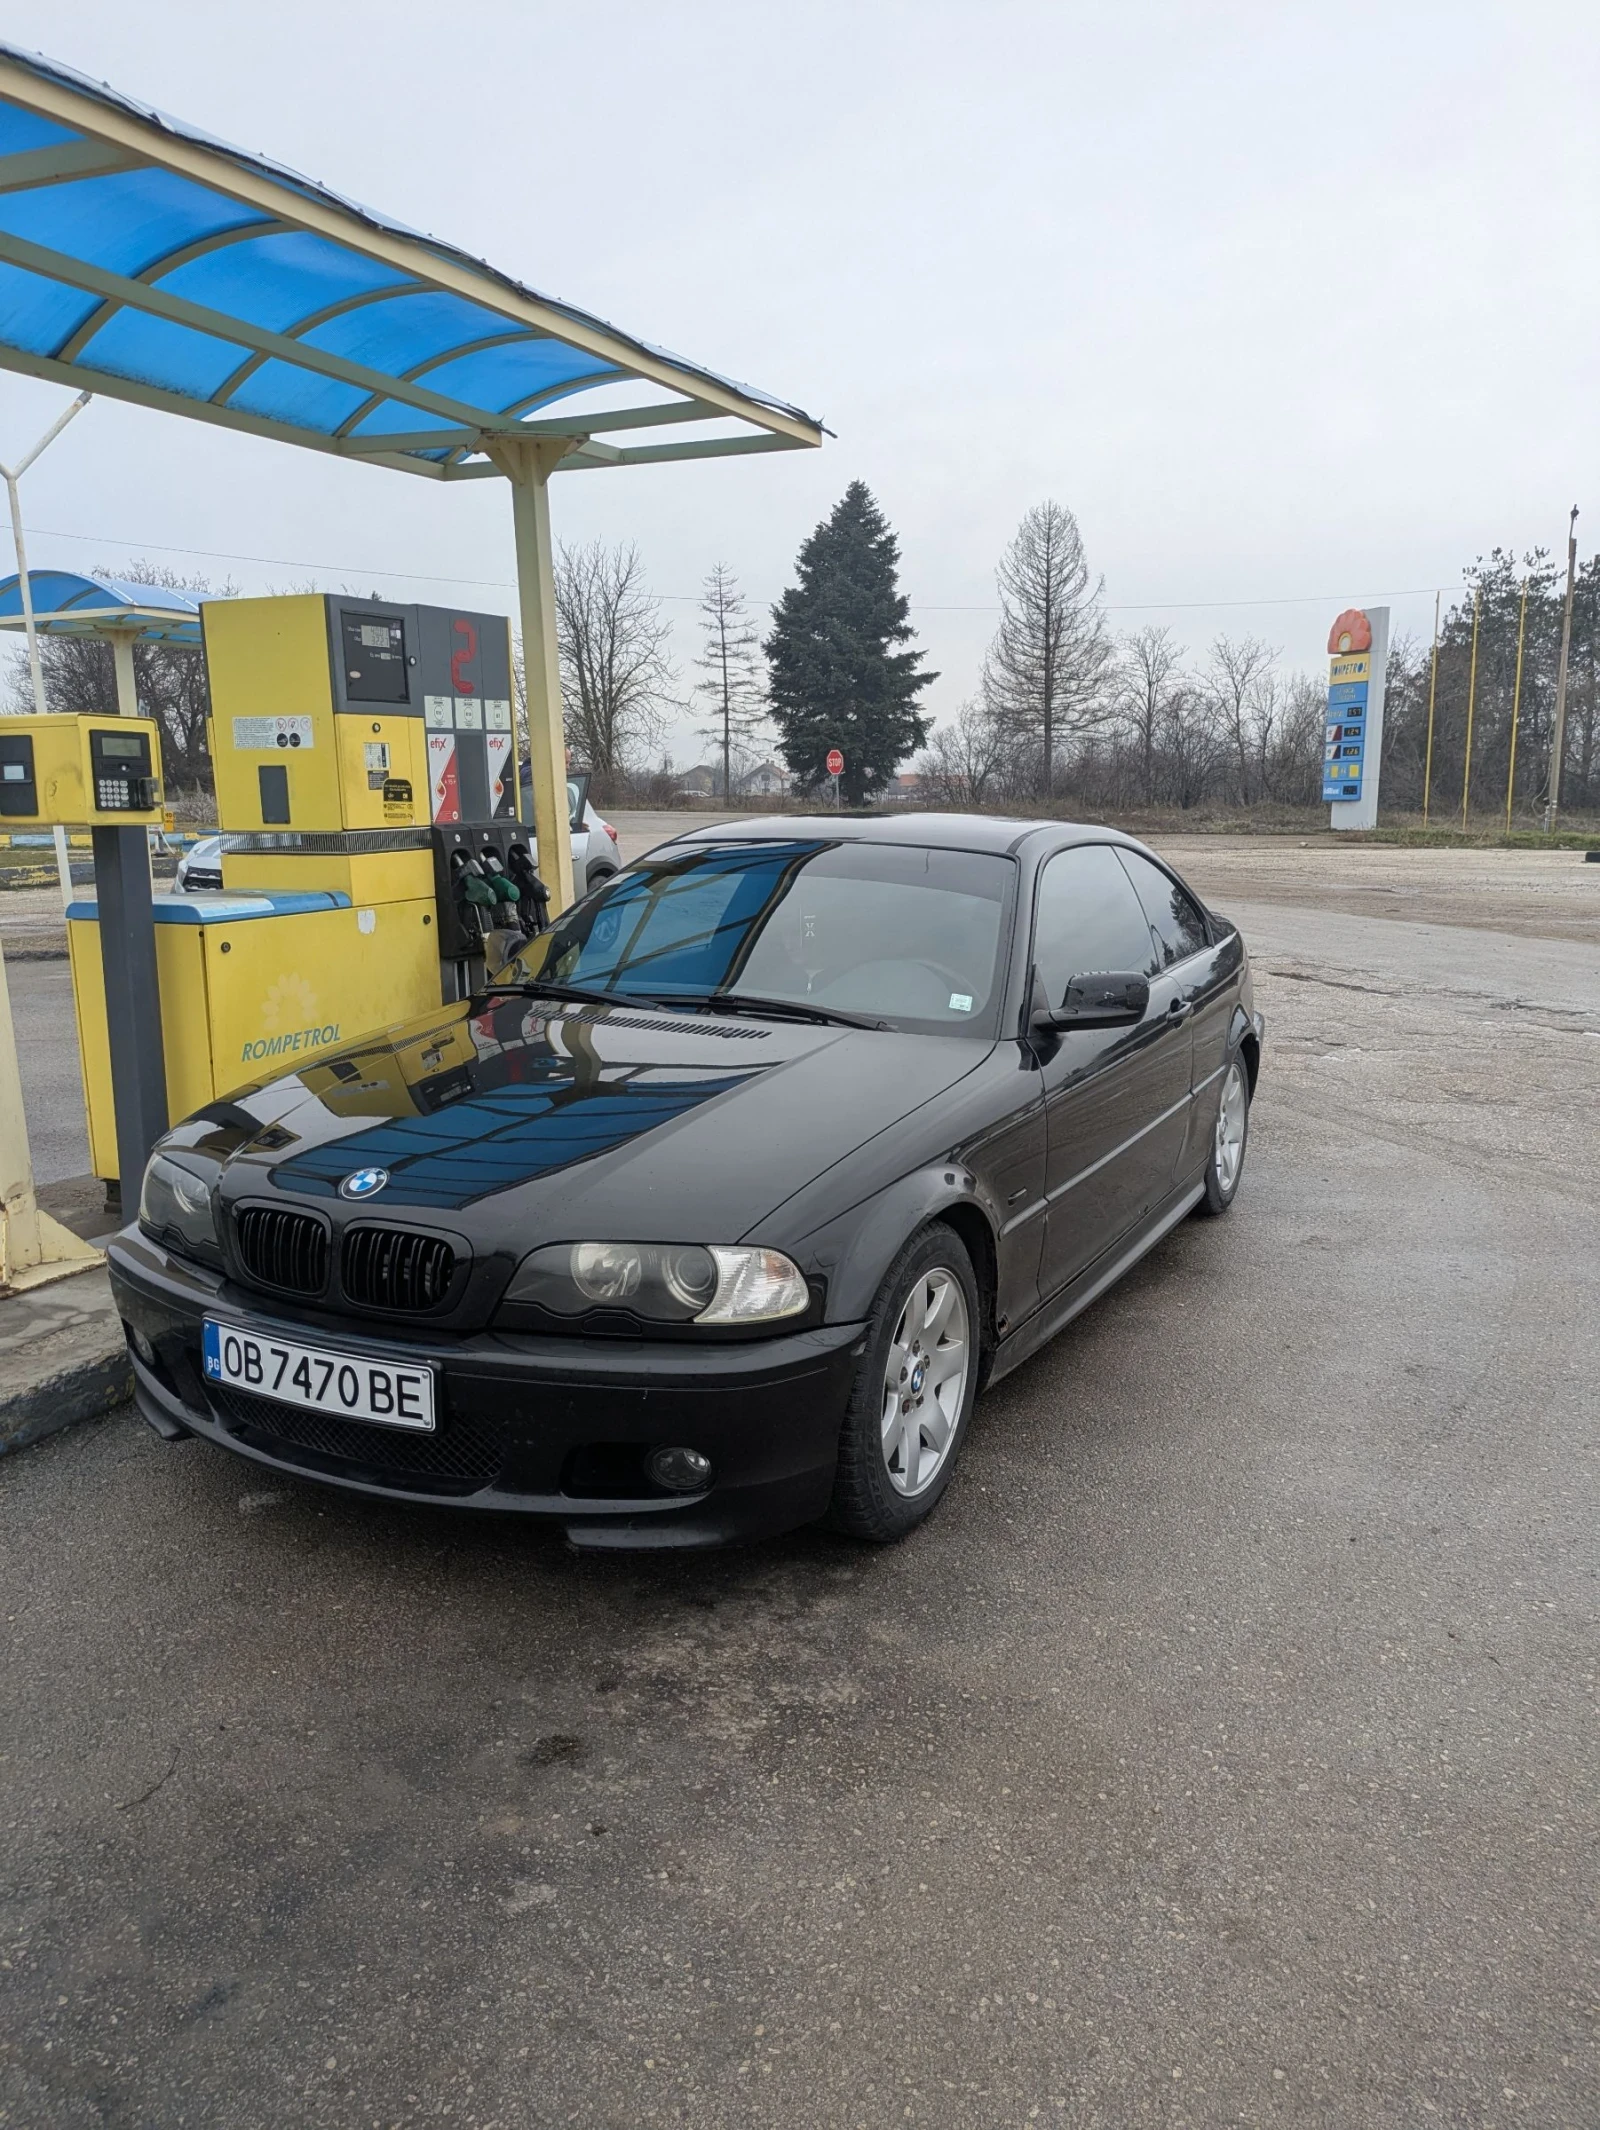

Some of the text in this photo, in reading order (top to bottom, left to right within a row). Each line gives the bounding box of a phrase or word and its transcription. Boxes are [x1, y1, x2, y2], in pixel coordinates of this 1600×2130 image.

[451, 618, 476, 694] 2
[430, 738, 447, 751] efix
[489, 738, 504, 750] efix
[828, 758, 842, 767] STOP
[242, 1024, 340, 1062] ROMPETROL
[207, 1355, 220, 1371] BG
